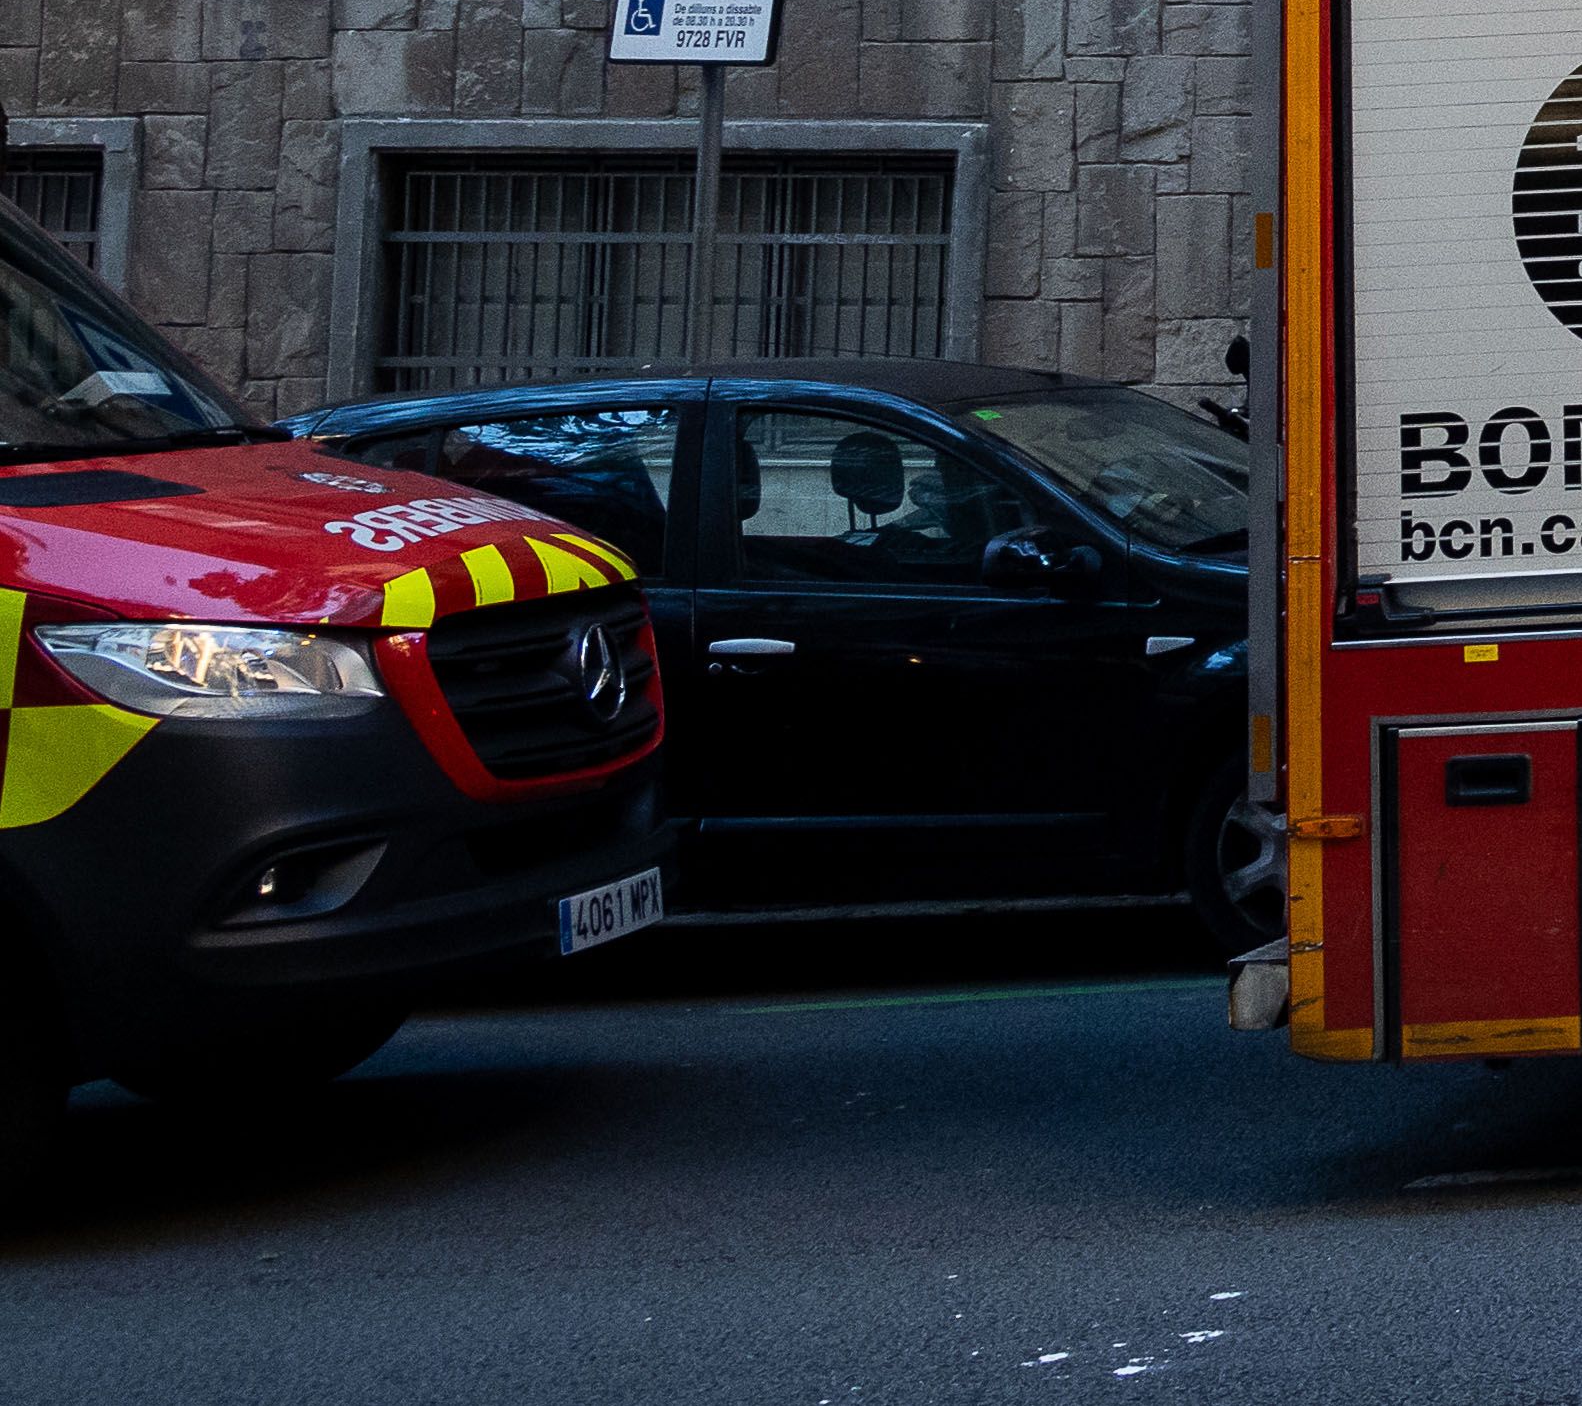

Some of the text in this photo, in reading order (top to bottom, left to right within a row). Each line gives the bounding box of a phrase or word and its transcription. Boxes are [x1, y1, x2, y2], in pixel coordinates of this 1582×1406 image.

[676, 30, 746, 48] 9728 FVR
[576, 873, 659, 941] 4061 MPX
